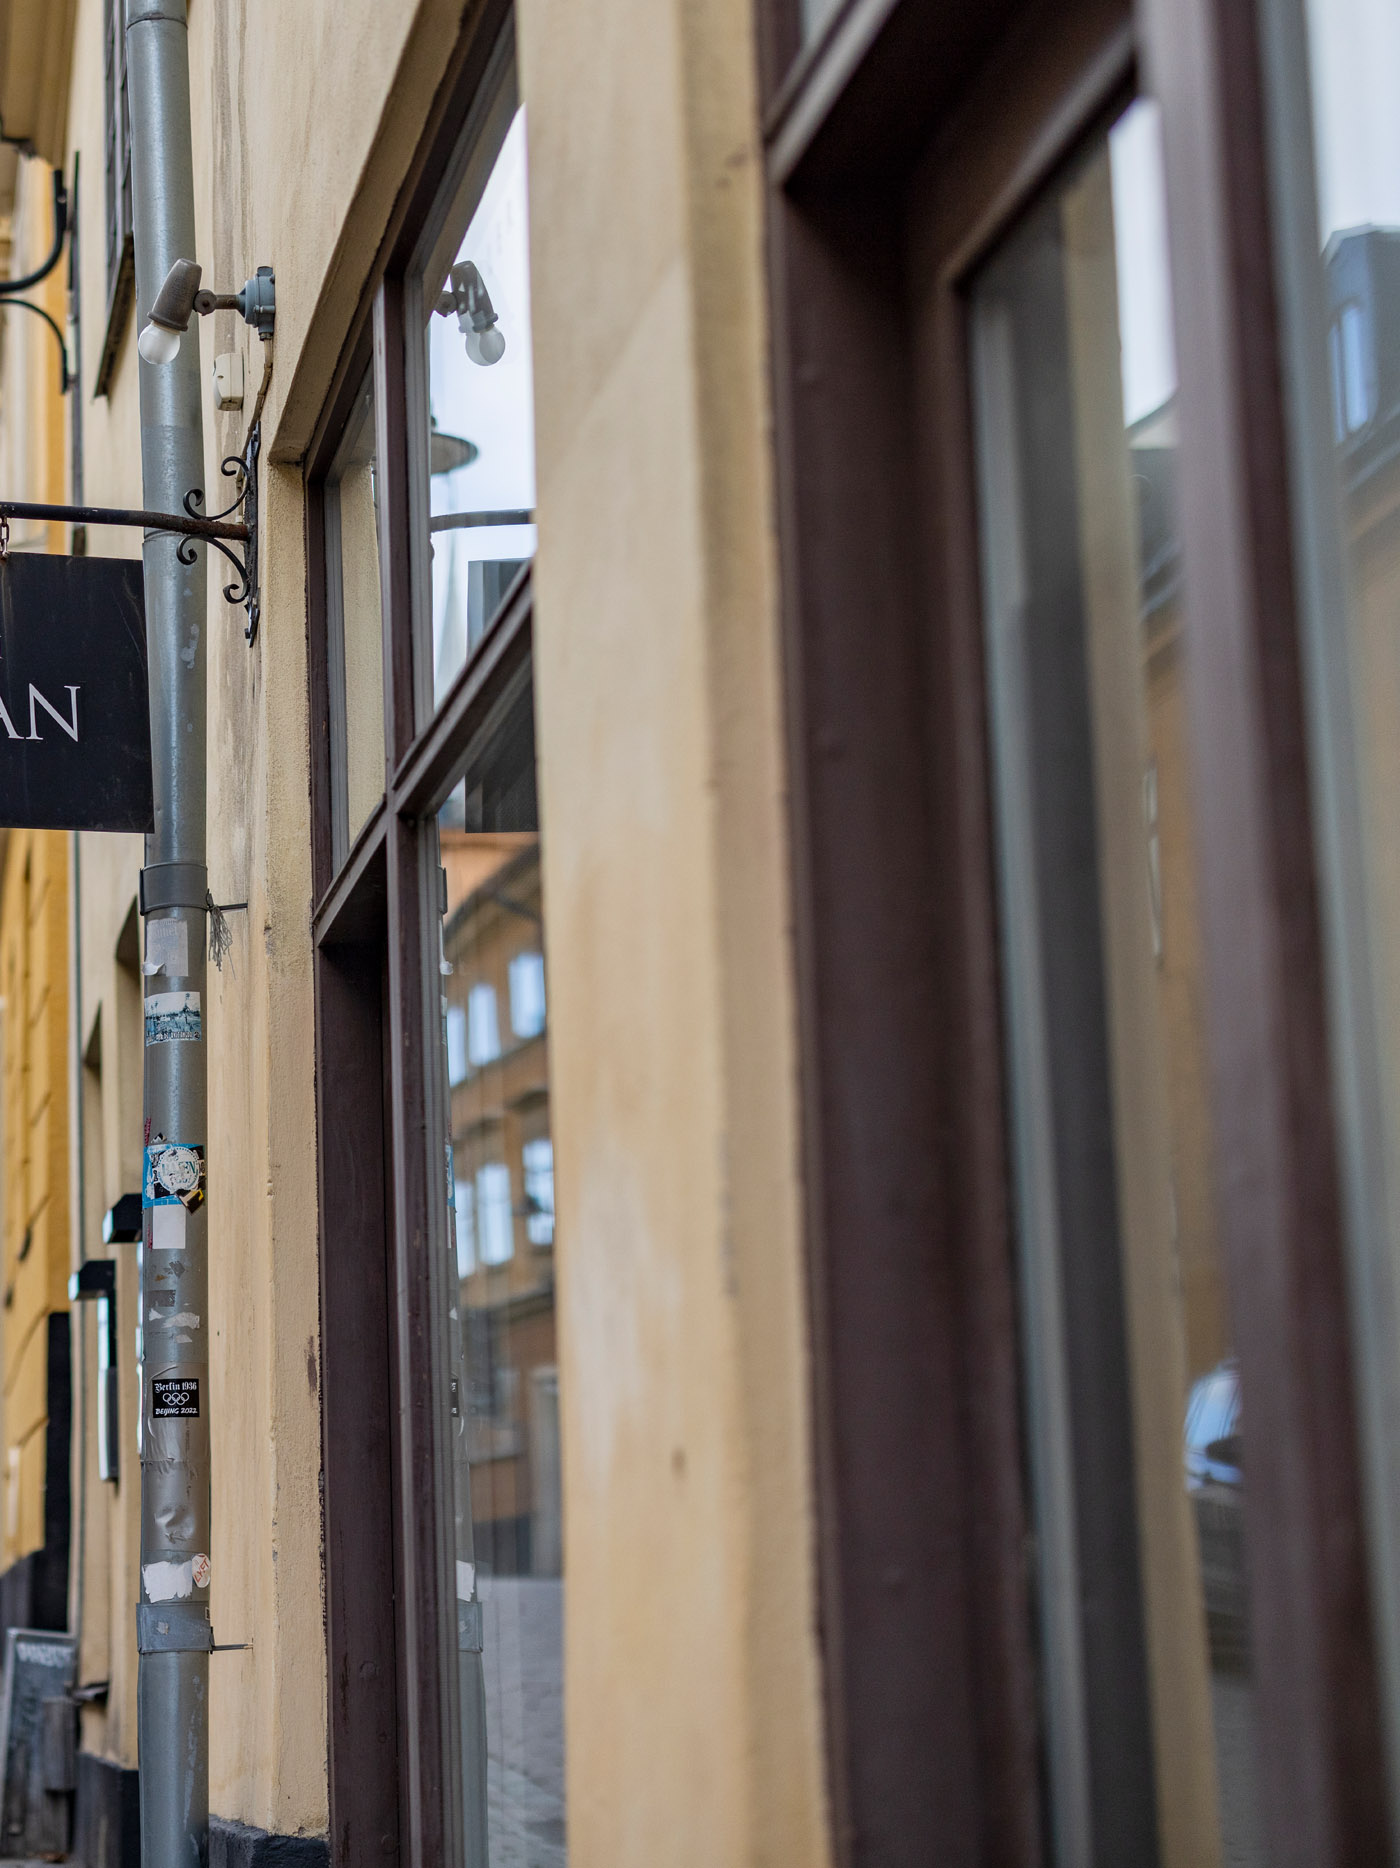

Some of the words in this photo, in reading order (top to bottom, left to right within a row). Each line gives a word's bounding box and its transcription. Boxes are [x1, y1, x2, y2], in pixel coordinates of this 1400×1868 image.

[154, 1381, 180, 1393] Berlin
[182, 1381, 197, 1391] 1936
[155, 1407, 180, 1416] BEIJING
[180, 1407, 198, 1415] 2022
